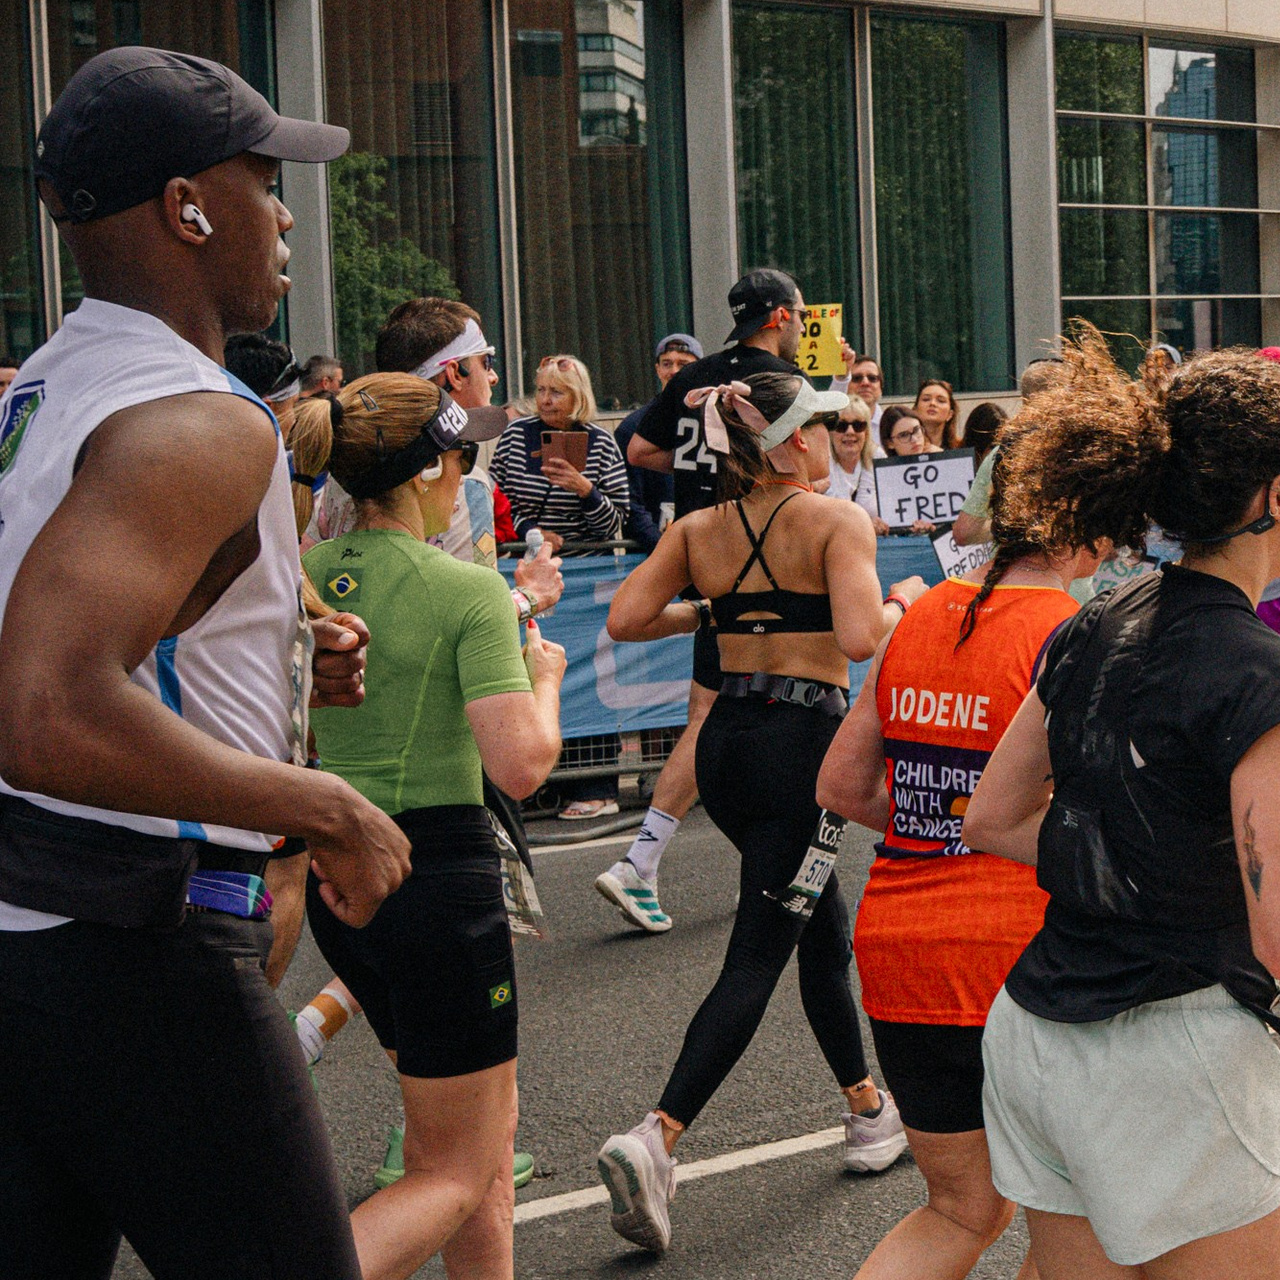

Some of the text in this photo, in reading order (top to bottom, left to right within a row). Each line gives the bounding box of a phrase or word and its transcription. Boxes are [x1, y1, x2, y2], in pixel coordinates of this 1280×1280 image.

[804, 309, 827, 319] ALE
[903, 464, 939, 490] GO
[895, 488, 970, 523] FRED
[753, 623, 765, 634] alo
[889, 687, 990, 732] JODENE
[894, 760, 983, 794] CHILDRE
[895, 786, 943, 815] WITH
[893, 812, 963, 839] CANCE
